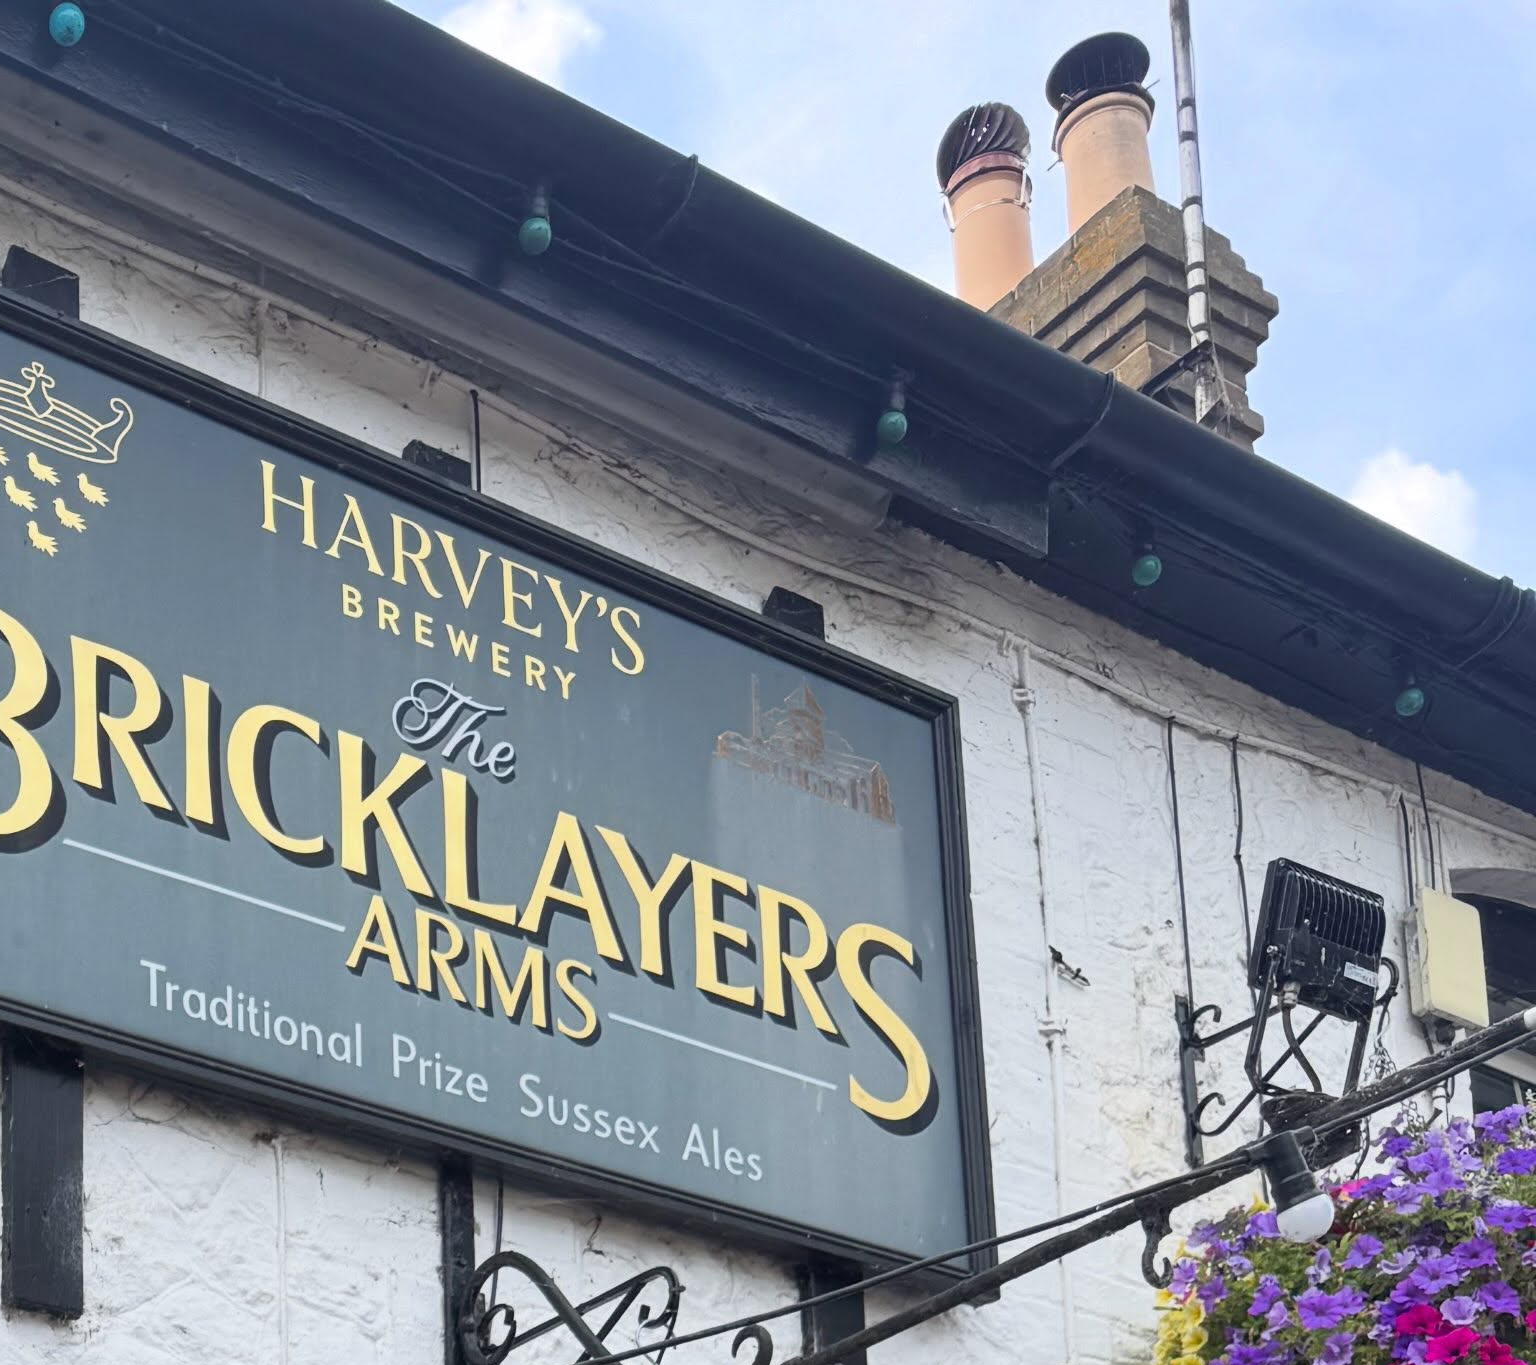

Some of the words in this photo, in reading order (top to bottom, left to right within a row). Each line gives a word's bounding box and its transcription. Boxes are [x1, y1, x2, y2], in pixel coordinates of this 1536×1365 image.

[260, 459, 646, 677] HARVEY'S
[342, 584, 576, 701] BREWERY
[392, 678, 516, 779] The
[346, 894, 602, 1046] ARMS
[139, 960, 363, 1067] Traditional
[391, 1036, 489, 1105] Prize
[519, 1072, 660, 1155] Sussex
[681, 1119, 763, 1182] Ales
